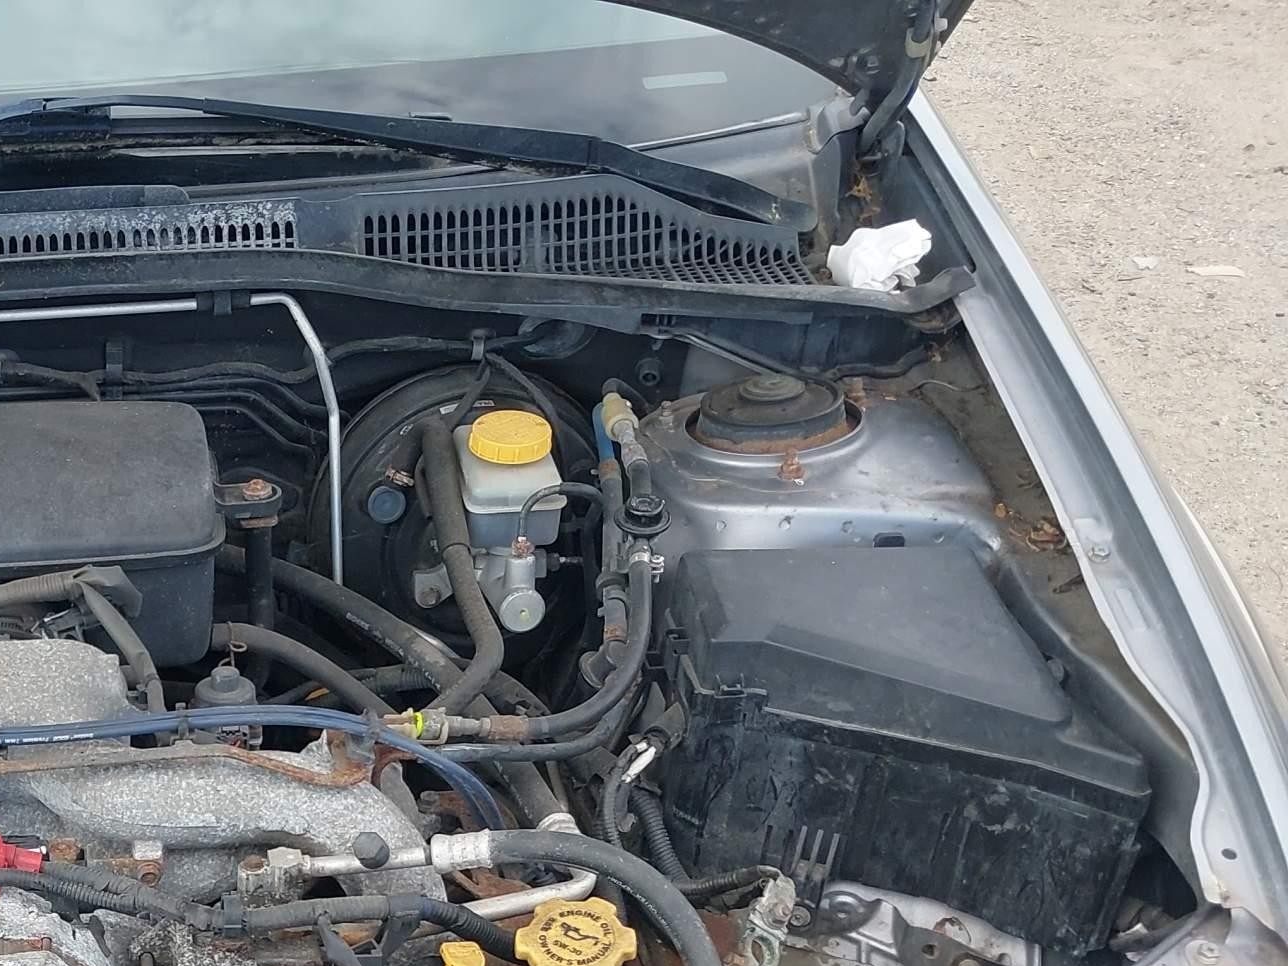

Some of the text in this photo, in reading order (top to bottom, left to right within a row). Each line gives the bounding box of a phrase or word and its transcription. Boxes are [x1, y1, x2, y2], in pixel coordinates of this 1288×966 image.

[558, 910, 613, 937] ENGINE OIL
[538, 935, 574, 966] OWNER'S
[577, 941, 613, 966] MANUAL
